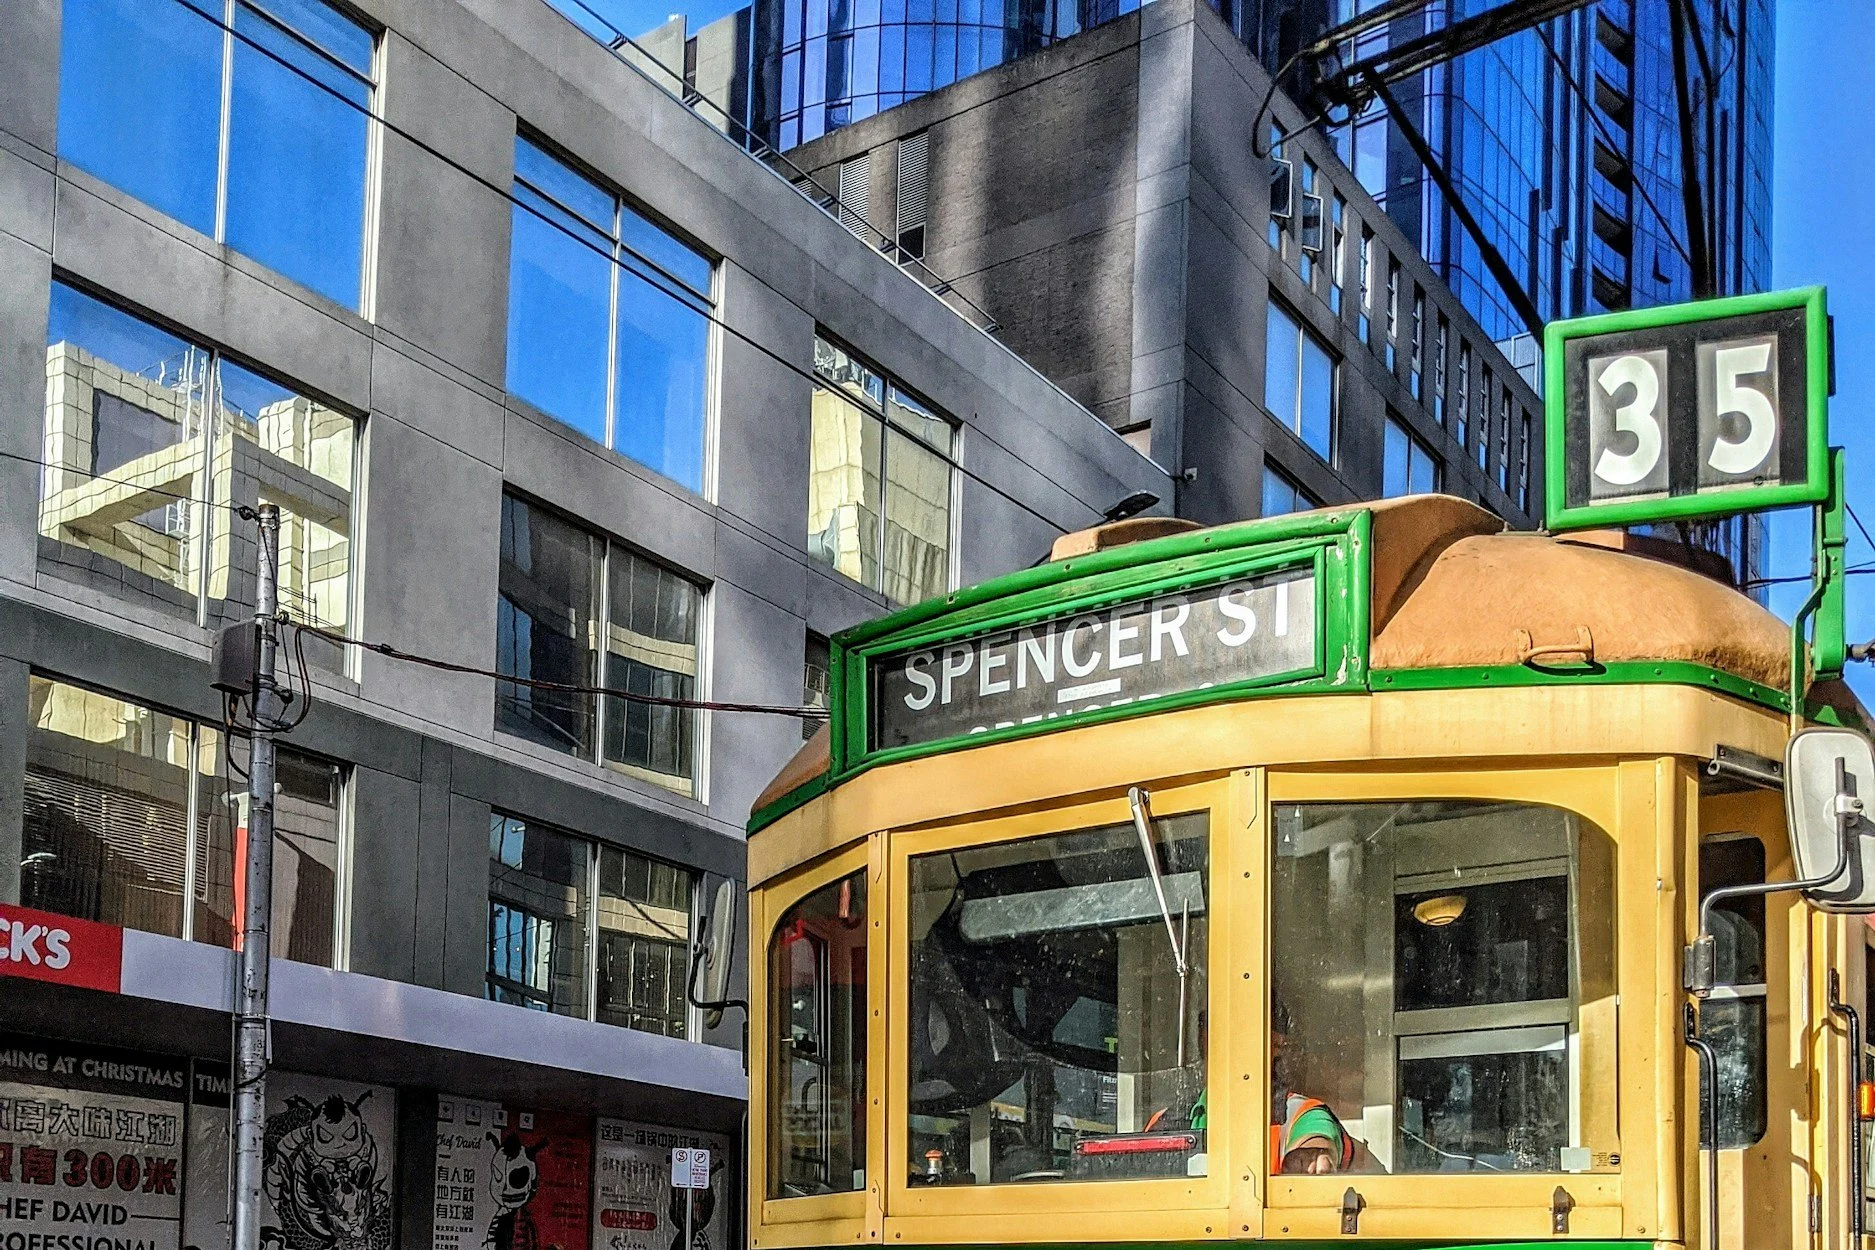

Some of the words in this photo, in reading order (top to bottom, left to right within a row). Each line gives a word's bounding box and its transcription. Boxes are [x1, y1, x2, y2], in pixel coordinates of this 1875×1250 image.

[1594, 342, 1776, 485] 35
[903, 595, 1191, 711] SPENCER
[1216, 574, 1296, 647] ST
[52, 1056, 77, 1075] AT
[82, 1058, 185, 1089] CHRISTMAS
[455, 1135, 482, 1150] David
[437, 1165, 475, 1184] 有人的
[52, 1200, 128, 1226] DAVID
